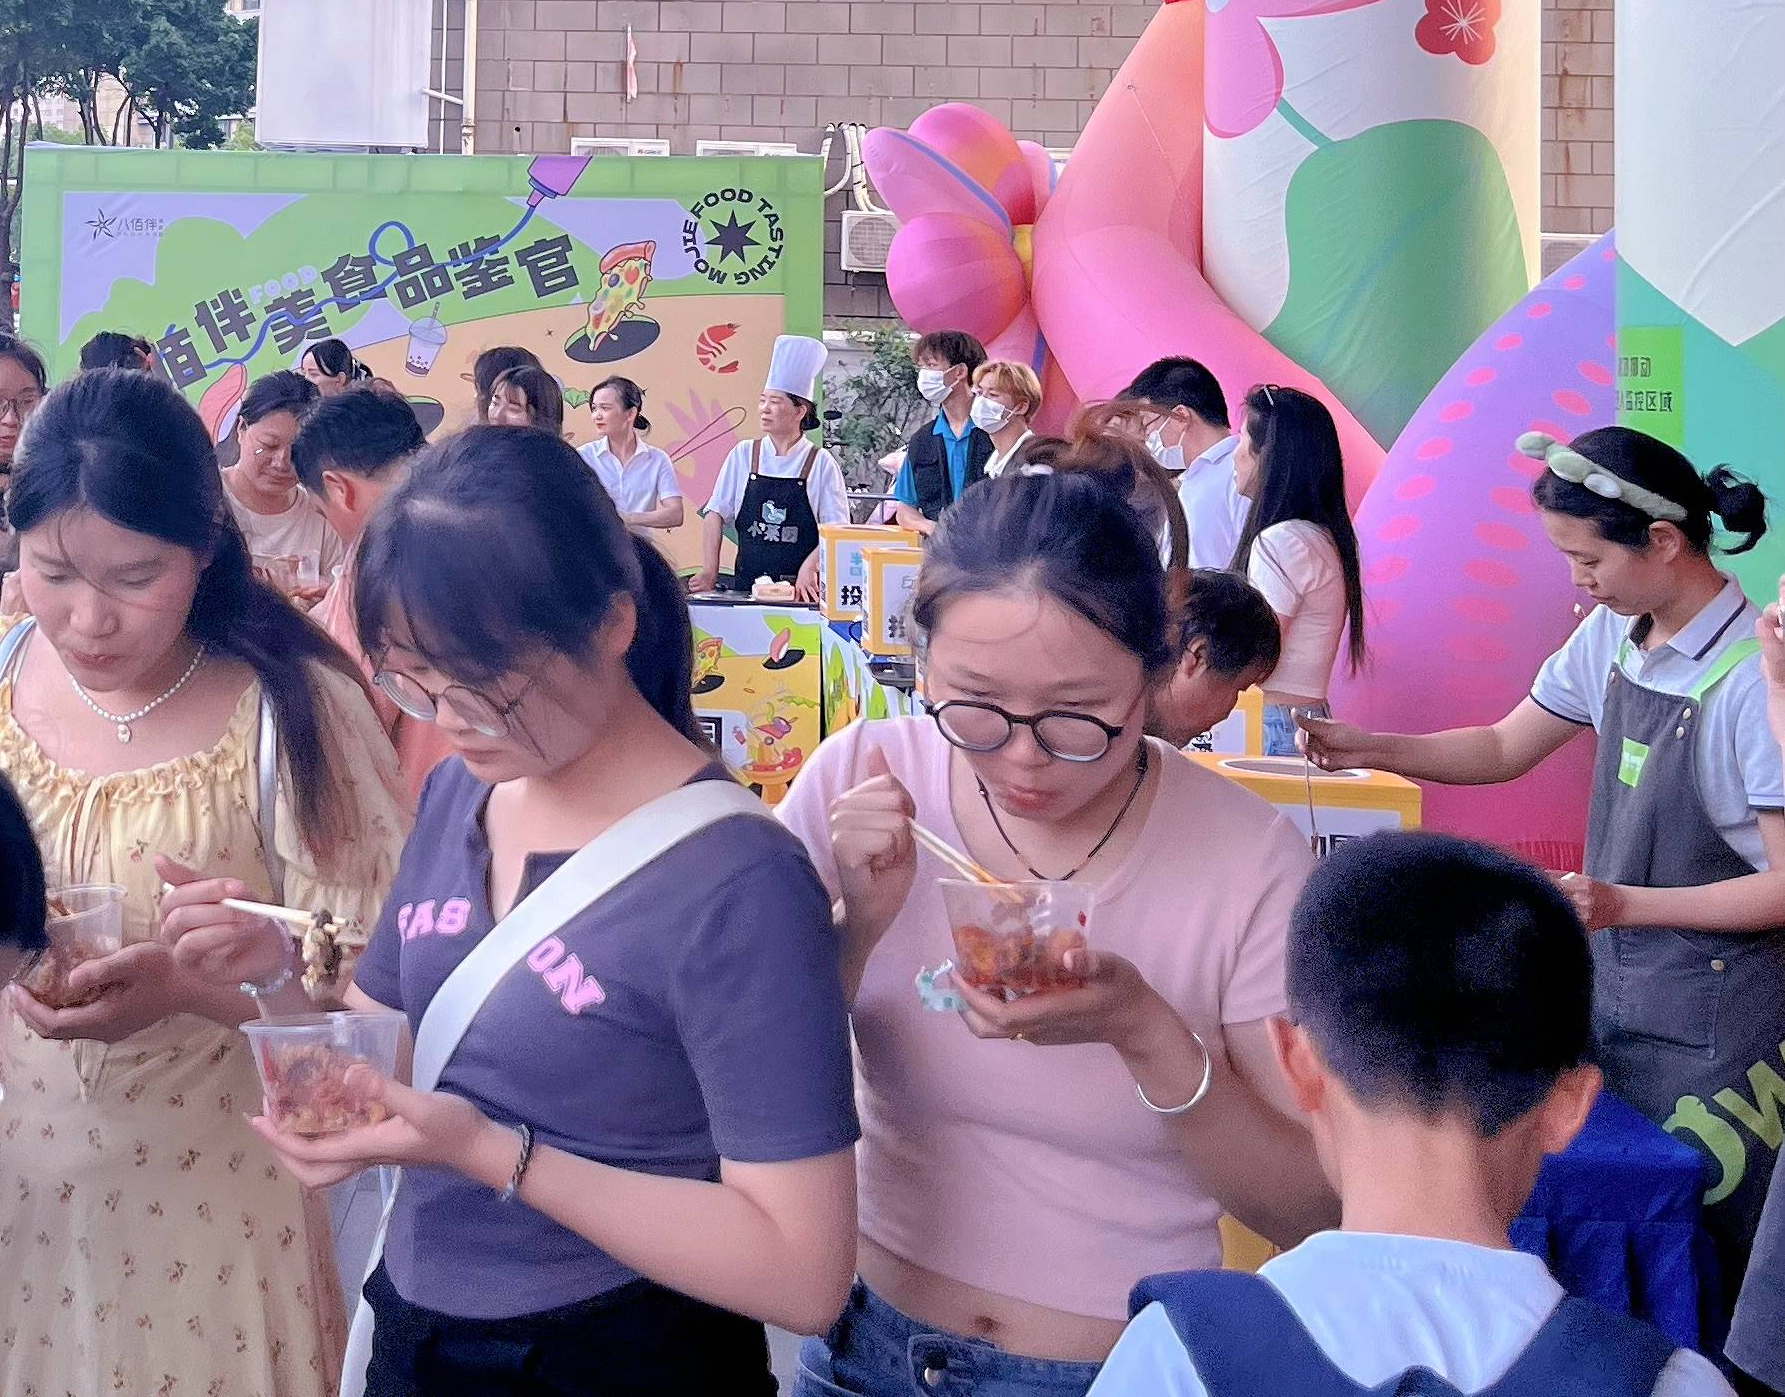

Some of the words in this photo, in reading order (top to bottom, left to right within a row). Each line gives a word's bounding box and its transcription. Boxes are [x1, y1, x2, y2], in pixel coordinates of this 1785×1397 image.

[690, 188, 753, 220] FOOD
[118, 218, 158, 233] 八佰伴
[733, 197, 784, 285] TASTING
[682, 219, 728, 285] MOJIE
[248, 265, 318, 305] FOOD
